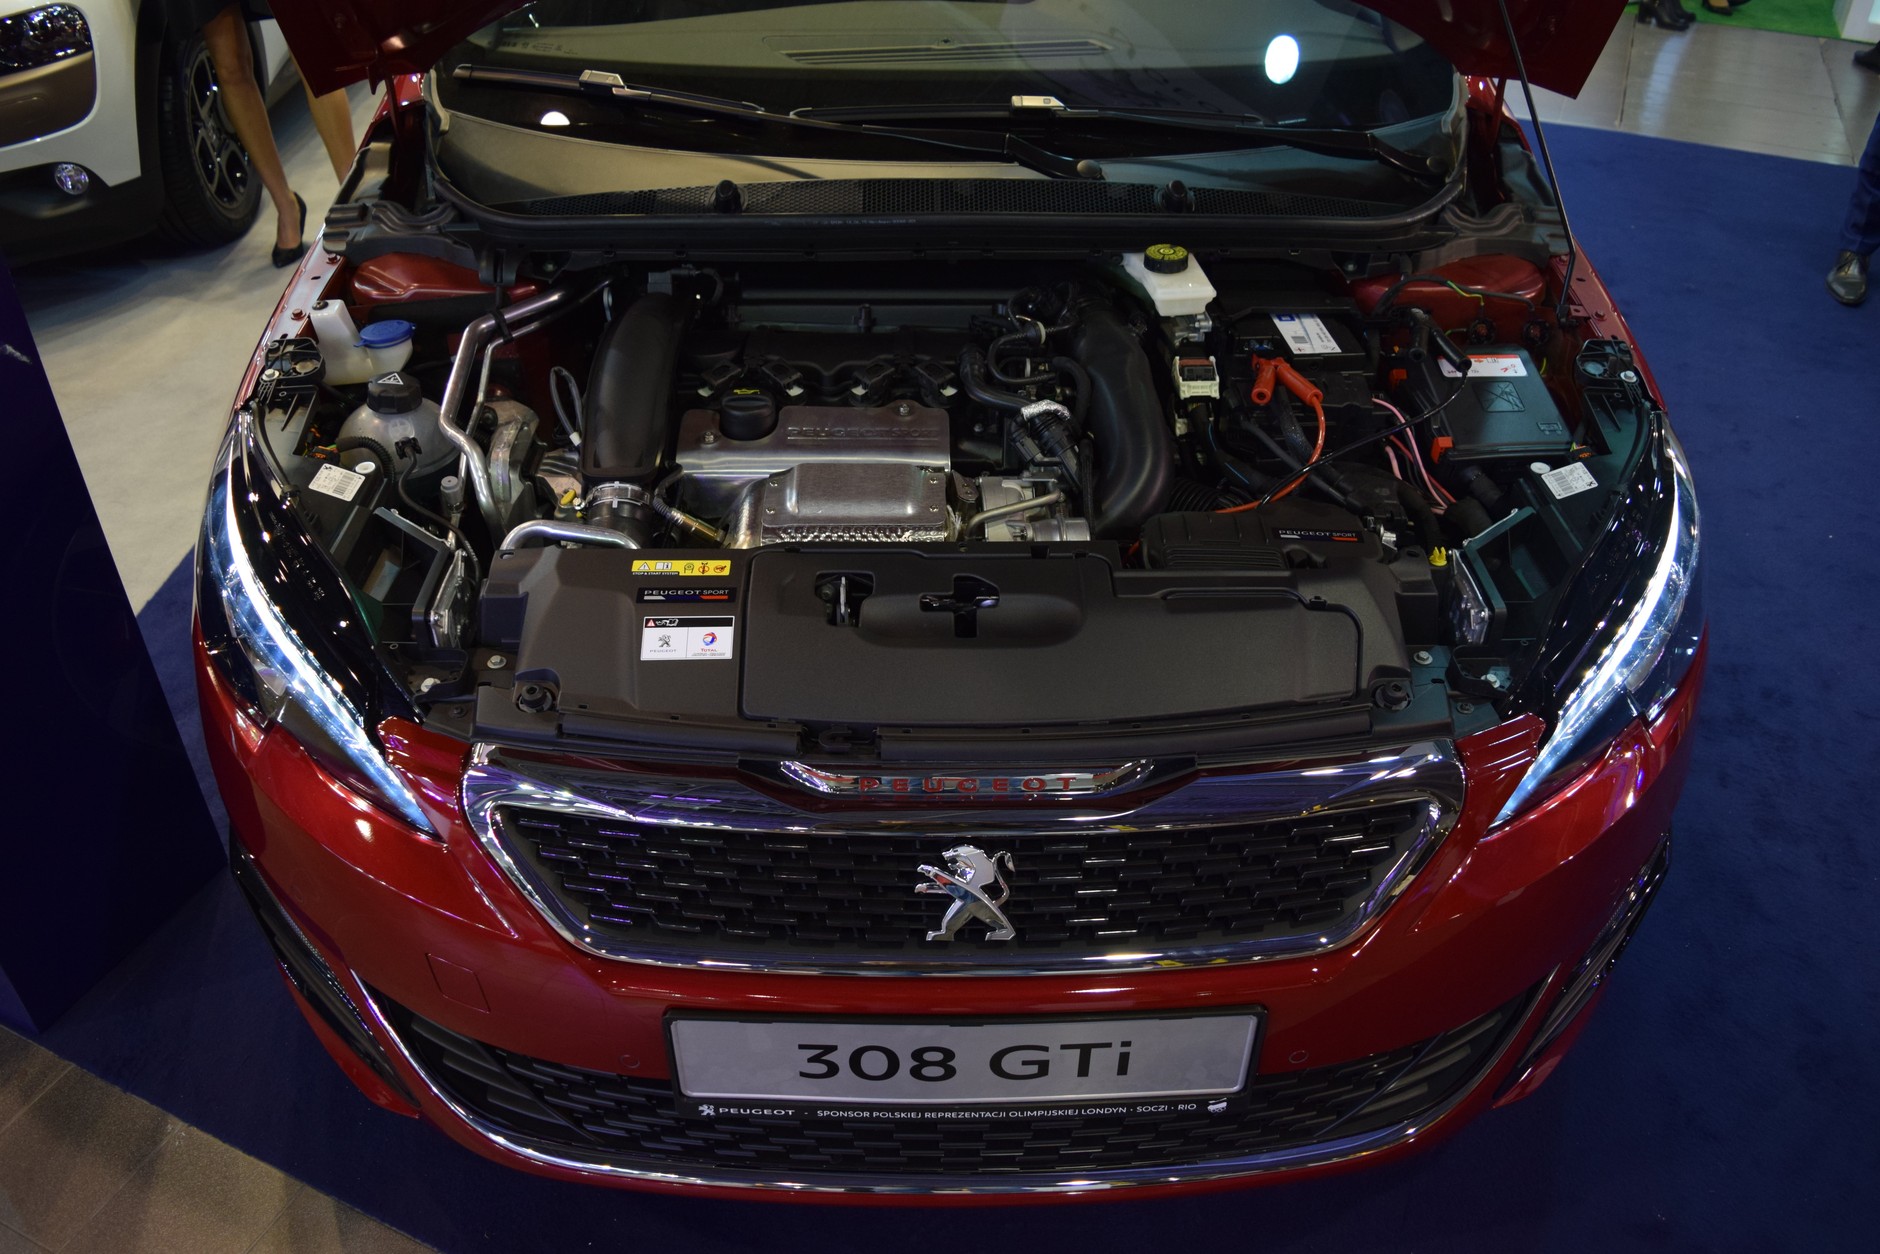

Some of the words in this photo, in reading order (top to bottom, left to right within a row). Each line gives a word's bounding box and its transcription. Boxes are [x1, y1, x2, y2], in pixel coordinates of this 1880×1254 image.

[1278, 529, 1330, 537] PEUGEOT
[858, 776, 1077, 793] PEUGEOT
[797, 1043, 958, 1082] 308
[989, 1040, 1132, 1081] GTi
[719, 1107, 796, 1116] PEUGEOT
[817, 1110, 870, 1118] SPONSOR
[872, 1111, 922, 1119] POLSKIEJ
[924, 1111, 1006, 1119] REPREZENTACJI
[1008, 1109, 1079, 1118] OLIMPIJSKIEJ
[1081, 1106, 1127, 1115] LONDYN
[1136, 1104, 1168, 1113] SOCZI
[1178, 1103, 1197, 1111] RIO
